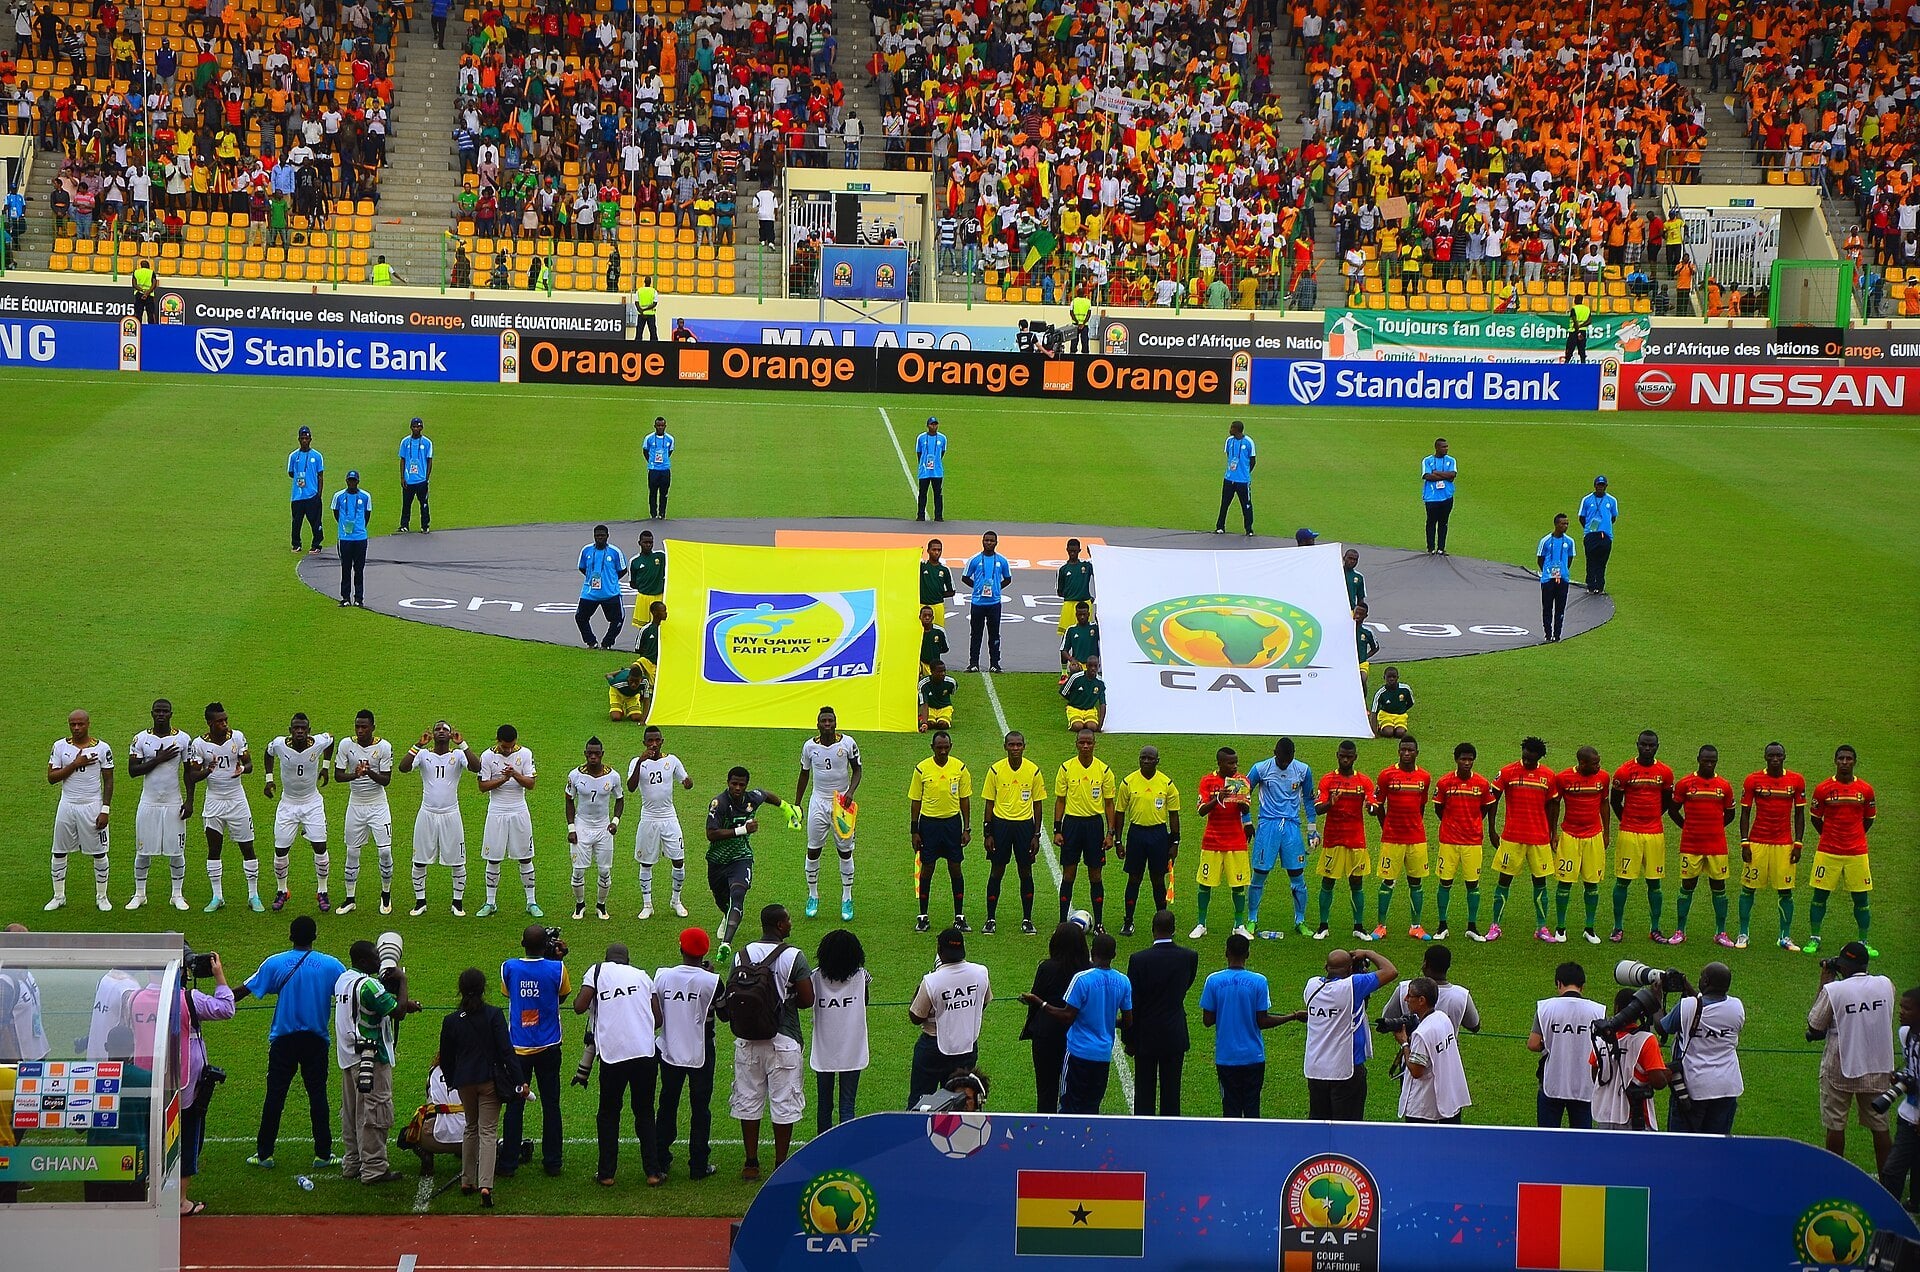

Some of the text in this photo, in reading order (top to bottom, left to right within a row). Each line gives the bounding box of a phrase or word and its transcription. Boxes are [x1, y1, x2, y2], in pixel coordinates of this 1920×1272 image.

[22, 295, 103, 316] ÉQUATORIALE
[105, 302, 135, 316] 2015
[195, 304, 244, 320] Coupe
[318, 308, 344, 322] des
[350, 310, 405, 326] Nations
[409, 312, 466, 329] Orange,
[470, 312, 513, 329] GUINÉE
[515, 315, 592, 332] ÉQUATORIALE
[594, 318, 622, 332] 2015
[1376, 317, 1448, 337] Toujours
[1453, 320, 1481, 337] fan
[1485, 322, 1516, 338] des
[1138, 332, 1185, 349] Coupe
[1255, 336, 1281, 349] des
[1286, 336, 1323, 350] Natio
[245, 337, 447, 373] Stanbic Bank
[1734, 342, 1760, 356] des
[1766, 341, 1819, 357] Nations
[530, 341, 666, 383] Orange
[721, 347, 856, 388] Orange
[680, 370, 706, 379] orange
[897, 352, 1031, 393] Orange
[1086, 358, 1219, 399] Orange
[1044, 381, 1070, 390] orange
[1335, 370, 1560, 401] Standard Bank
[1637, 384, 1673, 392] NISSAN
[1690, 371, 1906, 408] NISSAN
[733, 636, 758, 645] MY
[733, 645, 810, 654] FAIR PLAY
[817, 662, 869, 679] FIFA
[1159, 670, 1303, 693] CAF
[216, 755, 231, 769] 21
[824, 758, 832, 770] 3
[296, 764, 304, 776] 6
[435, 765, 446, 778] 11
[649, 771, 663, 785] 23
[590, 790, 598, 803] 7
[1325, 855, 1333, 868] 7
[1381, 856, 1391, 869] 13
[1438, 857, 1445, 870] 2
[1558, 859, 1573, 872] 20
[1621, 857, 1631, 870] 17
[1681, 856, 1689, 869] 5
[1202, 863, 1210, 876] 8
[1744, 866, 1759, 880] 23
[1814, 865, 1826, 879] 10
[520, 989, 540, 998] 092
[600, 986, 639, 1001] CAF
[663, 990, 699, 1002] CAF
[941, 984, 978, 1001] CAF
[818, 997, 854, 1008] CAF
[1845, 999, 1883, 1014] CAF
[1309, 1006, 1339, 1018] CAF
[1550, 1023, 1588, 1035] CAF
[1693, 1028, 1732, 1039] CAF
[30, 1156, 99, 1172] GHANA
[1290, 1163, 1371, 1218] GUINÉE ÉQUATORIALE 2015
[806, 1236, 869, 1254] CAF
[1300, 1230, 1358, 1246] CAF
[1316, 1251, 1345, 1261] COUPE
[1316, 1262, 1361, 1272] D'AFRIQUE
